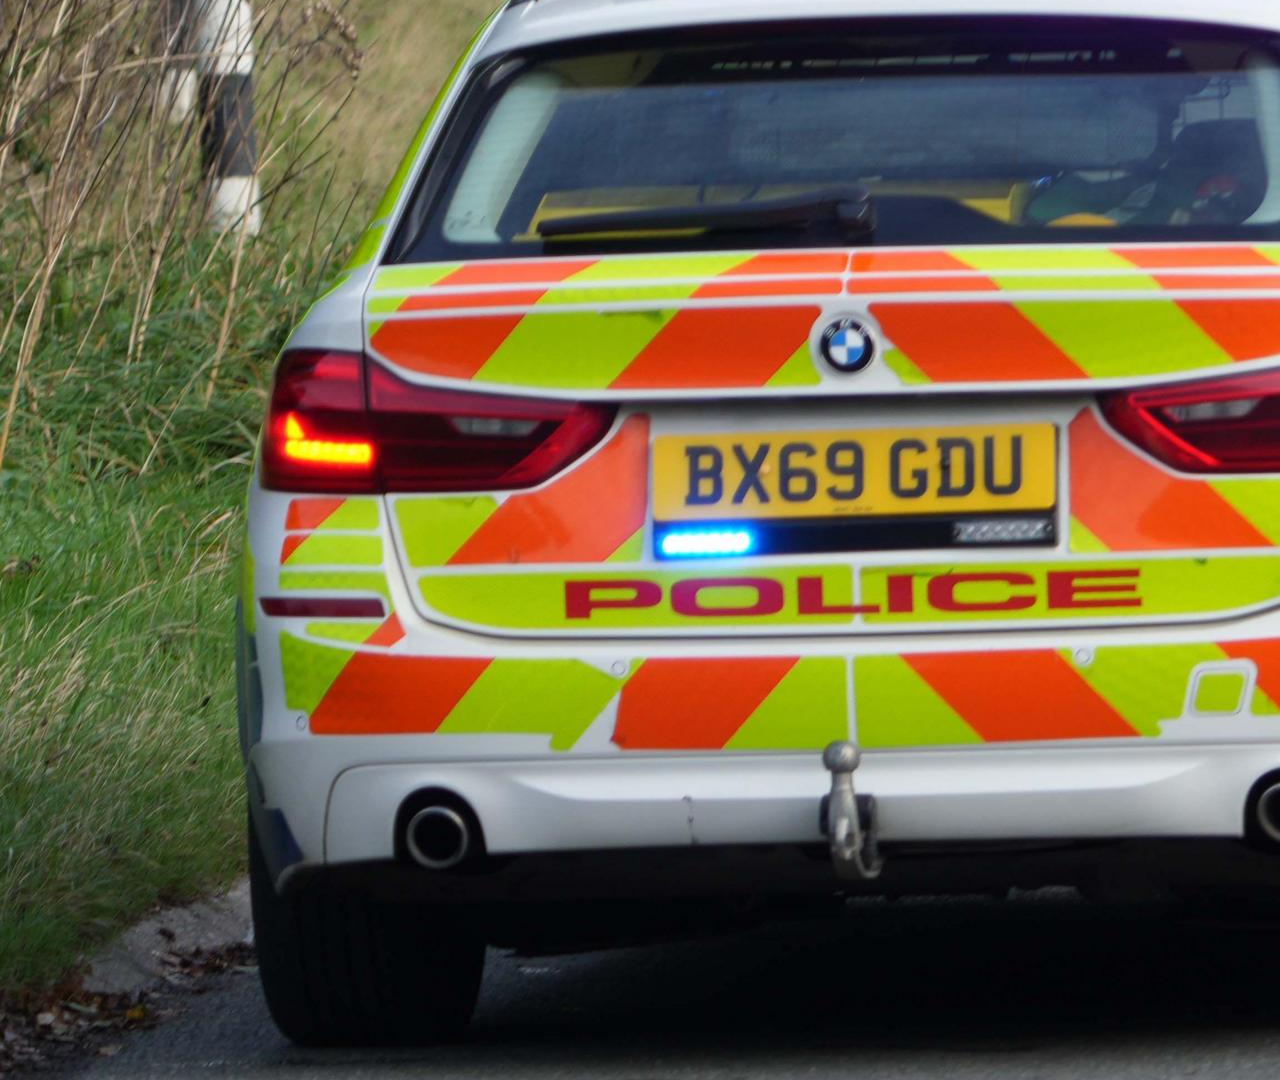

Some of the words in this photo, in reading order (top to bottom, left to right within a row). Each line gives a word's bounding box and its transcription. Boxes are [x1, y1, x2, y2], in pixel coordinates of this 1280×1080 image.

[684, 441, 864, 506] BX69
[888, 435, 1022, 498] GDU
[564, 567, 1142, 620] POLICE
